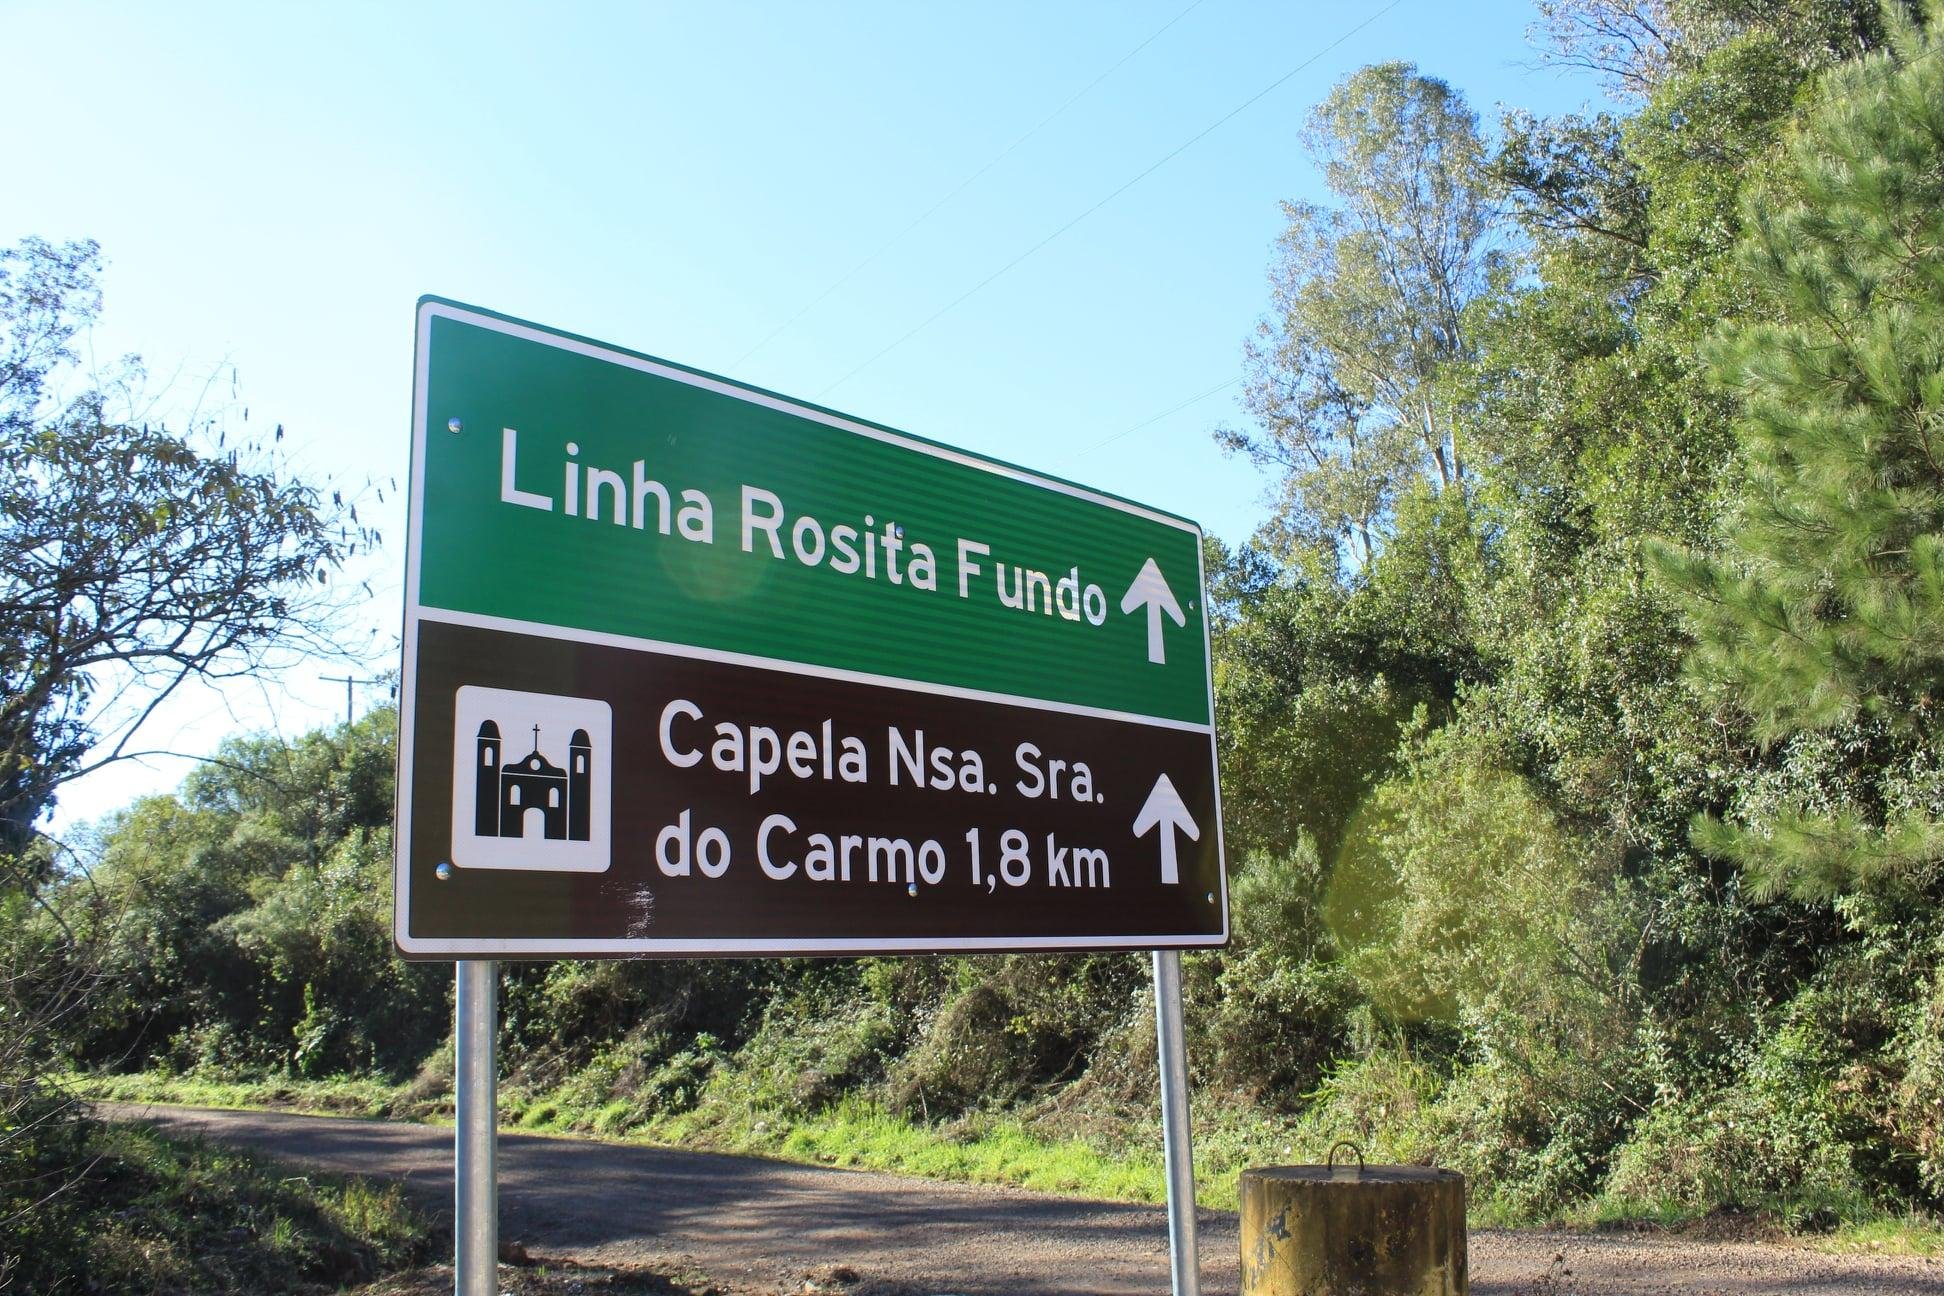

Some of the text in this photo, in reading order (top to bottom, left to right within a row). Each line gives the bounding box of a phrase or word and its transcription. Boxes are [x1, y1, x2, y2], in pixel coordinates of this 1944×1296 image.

[501, 427, 1107, 628] Linha Rosita Fundo
[659, 699, 1105, 803] Capela Nsa. Sra.
[655, 808, 1110, 896] do Carmo 1,8 km
